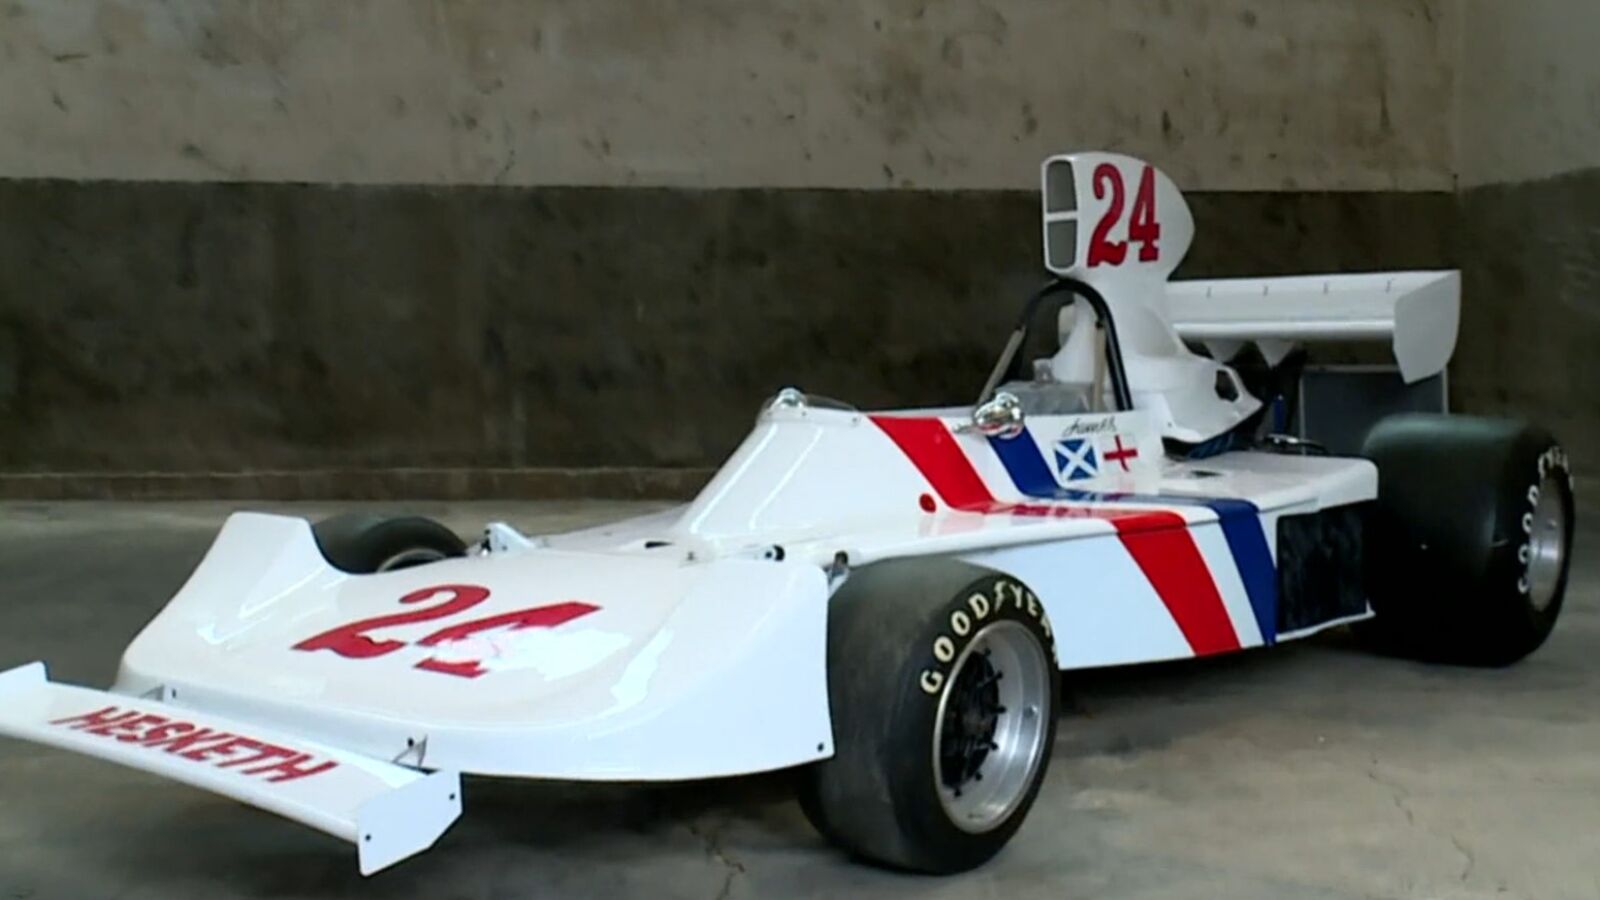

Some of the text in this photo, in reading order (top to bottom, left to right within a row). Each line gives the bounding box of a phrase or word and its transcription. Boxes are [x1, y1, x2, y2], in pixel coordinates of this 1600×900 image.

[1087, 163, 1160, 268] 24
[920, 580, 1058, 694] GOODYEA
[50, 706, 338, 782] HESKETH
